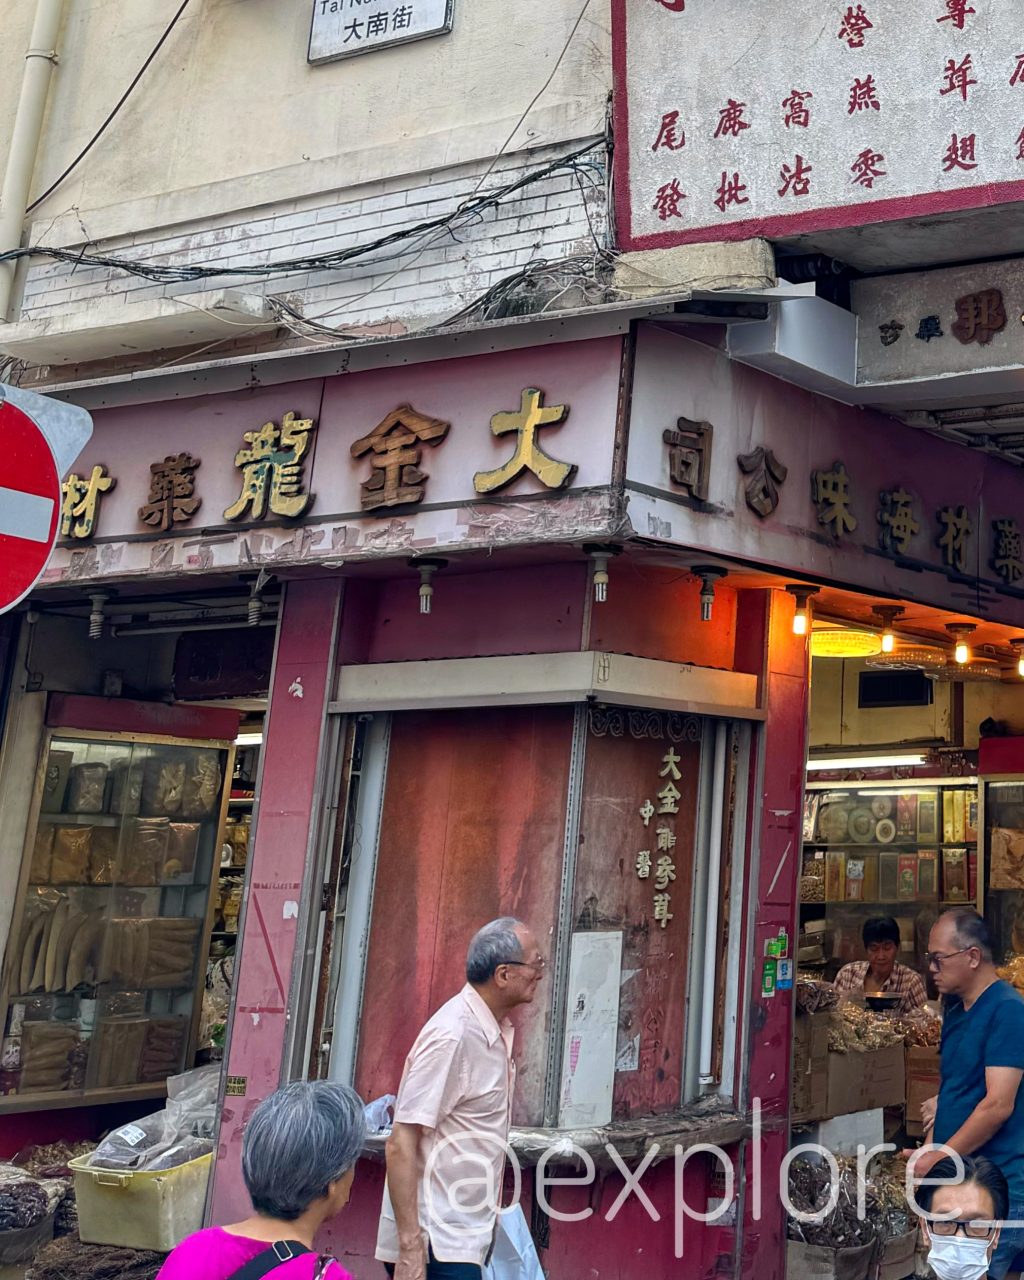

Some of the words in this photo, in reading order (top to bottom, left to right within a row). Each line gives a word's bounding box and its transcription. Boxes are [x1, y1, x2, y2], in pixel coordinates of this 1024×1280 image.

[343, 5, 414, 43] 大南街
[636, 799, 655, 880] 中醫
